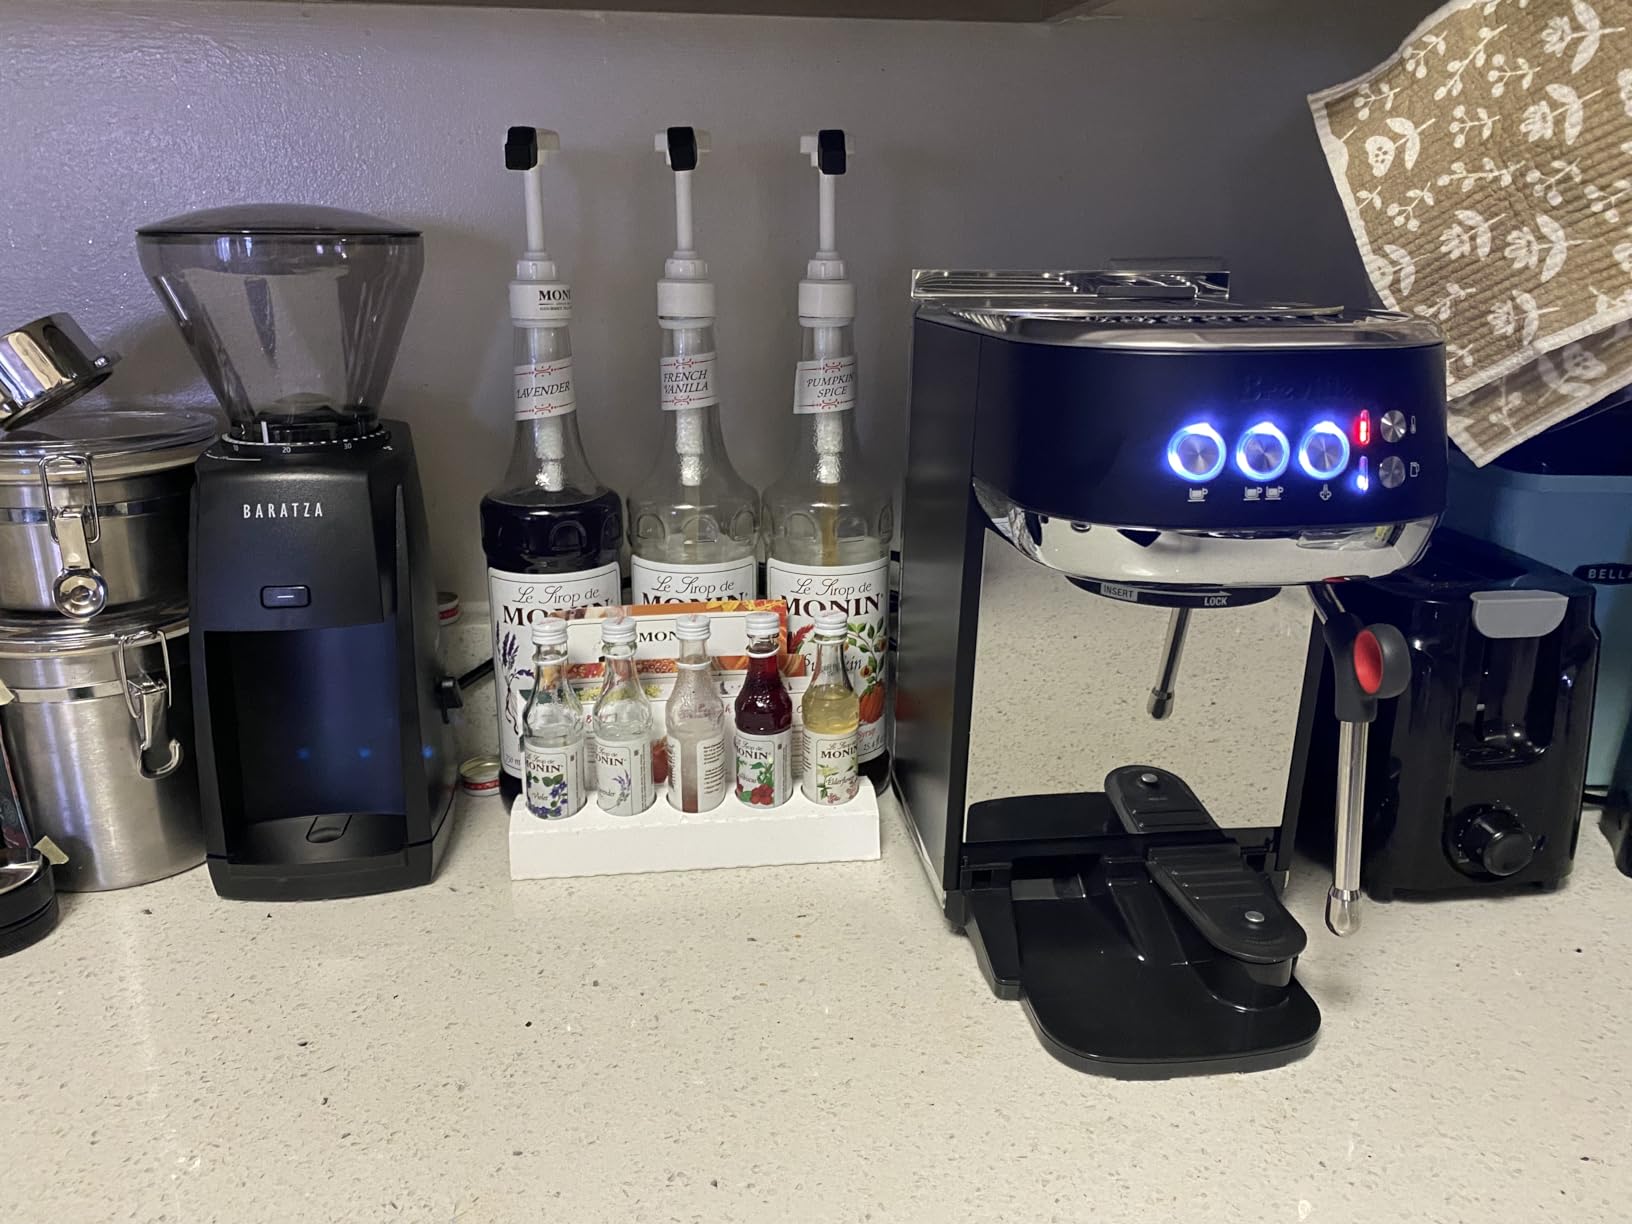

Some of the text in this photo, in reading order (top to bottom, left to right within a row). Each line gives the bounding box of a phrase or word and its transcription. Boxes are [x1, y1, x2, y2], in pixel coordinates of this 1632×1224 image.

[663, 369, 708, 383] FRENCH
[806, 372, 855, 388] PUMPKIN
[516, 381, 570, 399] LAVENDER
[663, 381, 709, 394] VANILLA
[817, 386, 848, 398] SPICE
[282, 446, 292, 454] 20
[343, 442, 352, 450] 30
[243, 502, 323, 519] BARATZA
[651, 576, 734, 596] Le Sirop de
[790, 578, 872, 599] Le Sirop de
[1103, 584, 1133, 598] INSERT
[512, 585, 599, 606] Le Sirop de
[1204, 596, 1228, 606] LOCK
[736, 747, 768, 760] ONIN
[526, 759, 561, 773] ONIN
